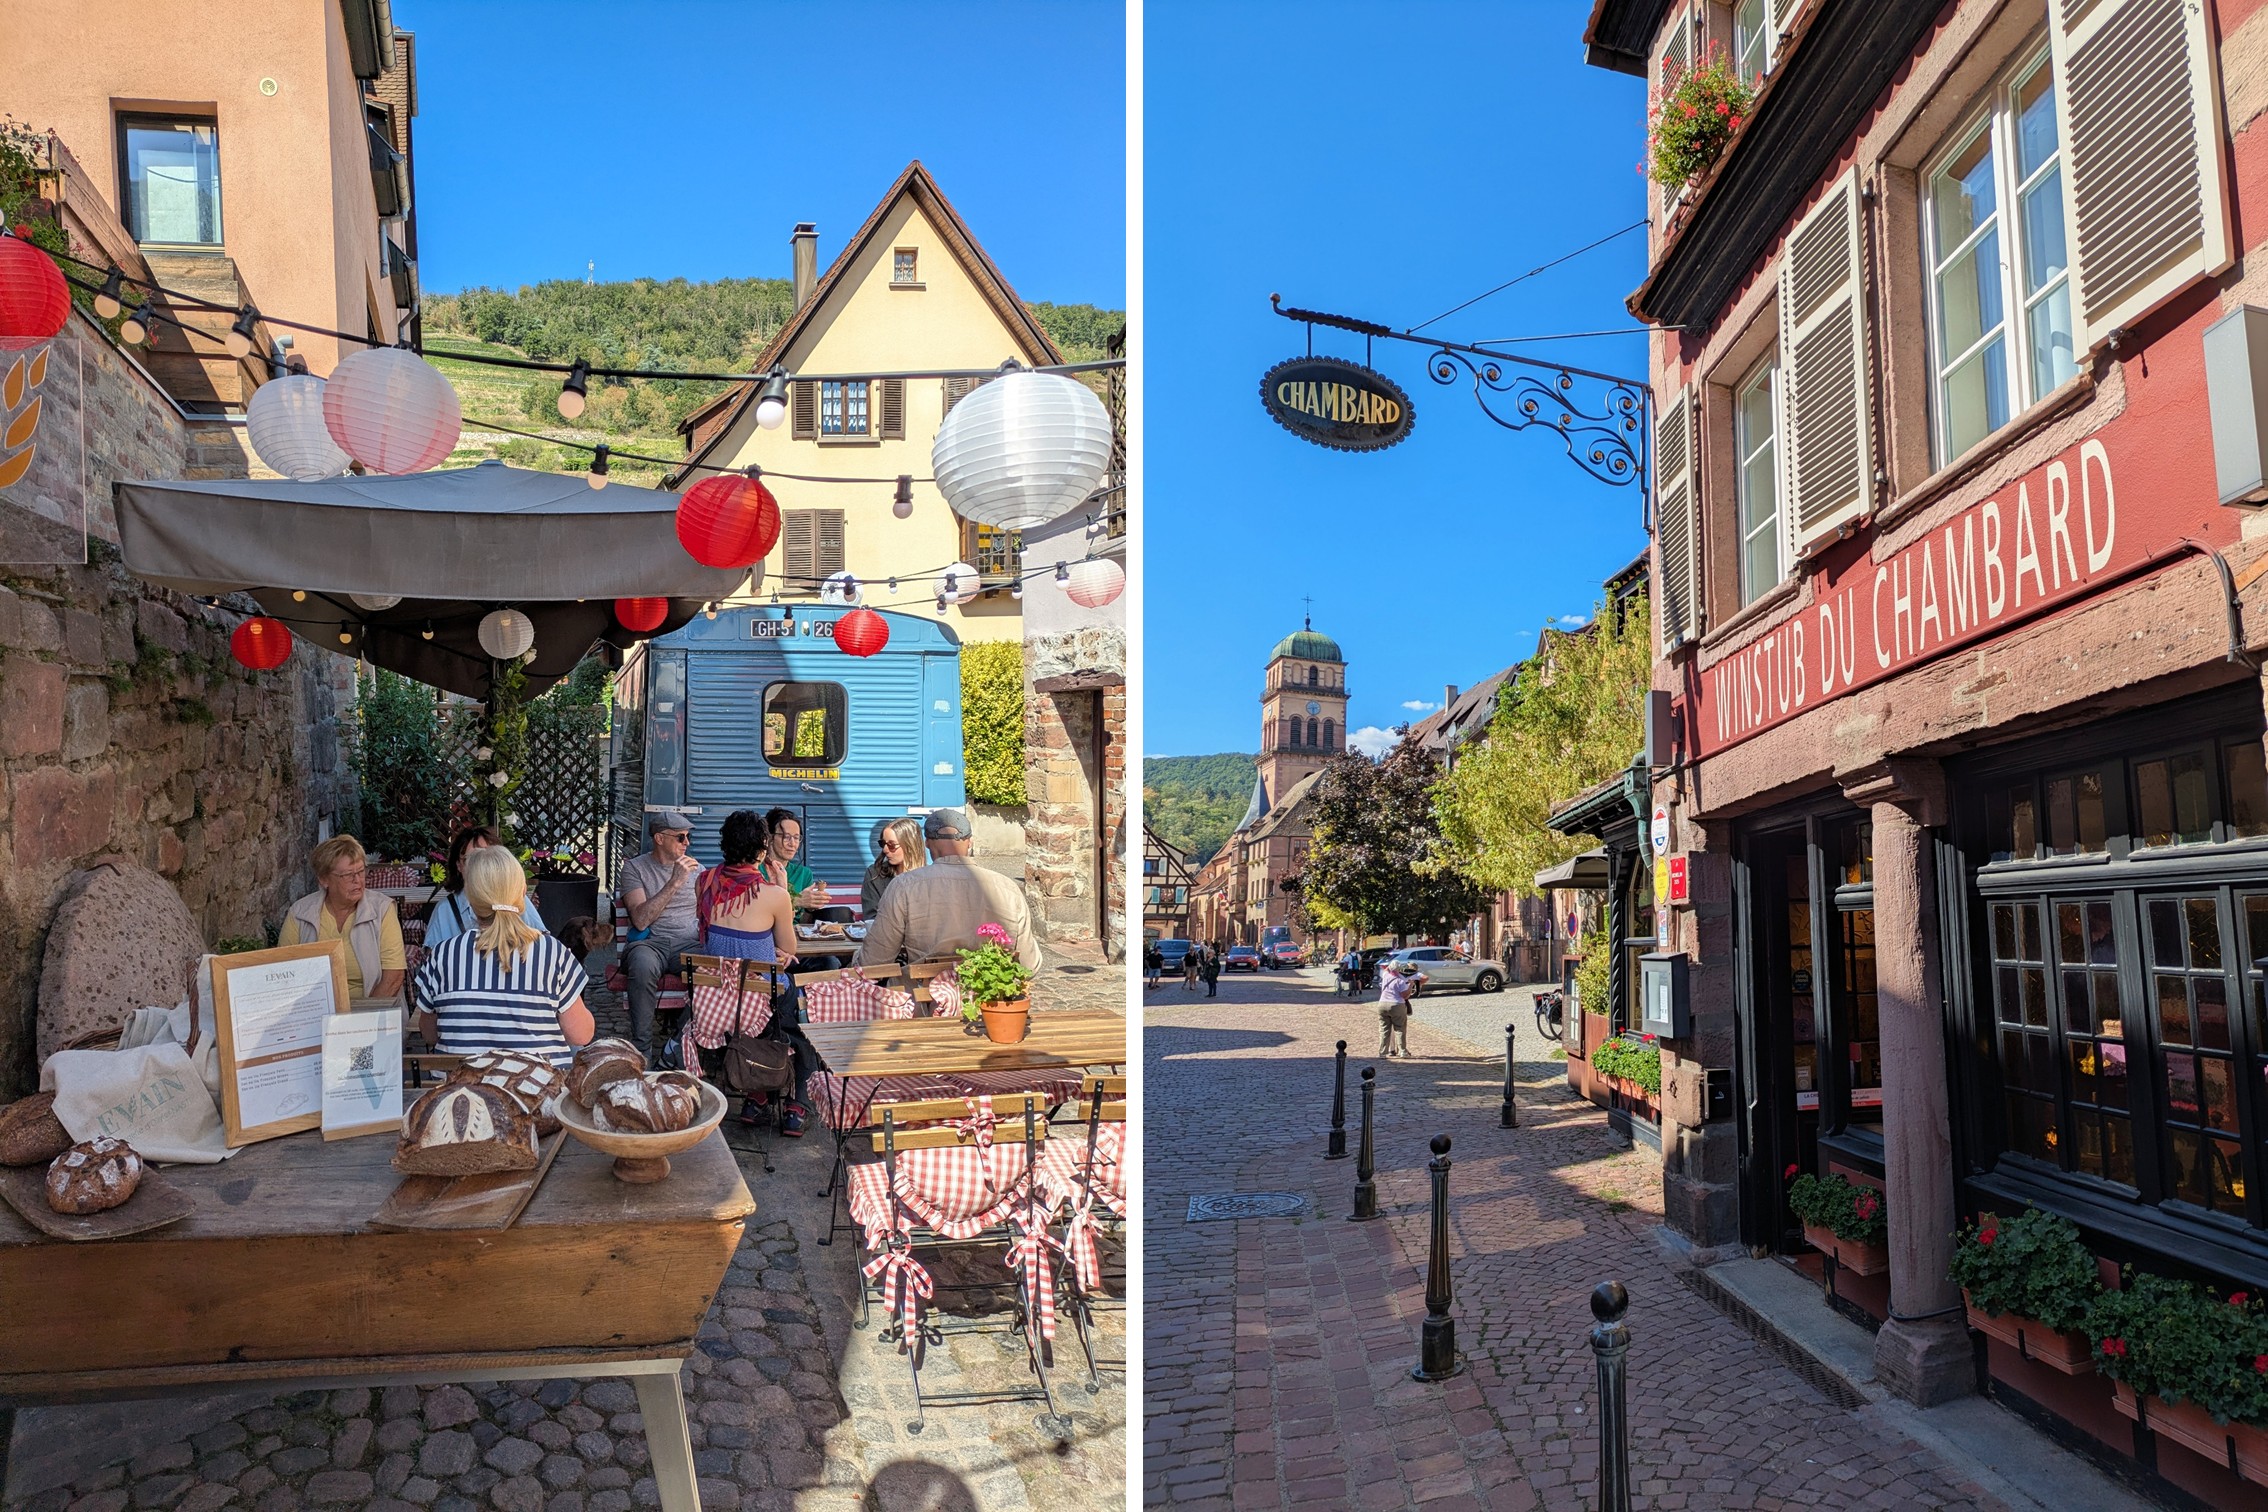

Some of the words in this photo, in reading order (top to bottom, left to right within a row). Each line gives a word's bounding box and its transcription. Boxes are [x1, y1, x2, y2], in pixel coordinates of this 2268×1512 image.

[1277, 381, 1401, 425] CHAMBARD
[1714, 618, 1805, 742] WINSTUB
[1819, 585, 1856, 696] DU
[1872, 438, 2117, 669] CHAMBARD
[771, 769, 838, 778] MICHELIN
[265, 970, 296, 982] LEVAIN
[282, 1051, 304, 1059] PRODUITS
[96, 1070, 187, 1137] EVAIN
